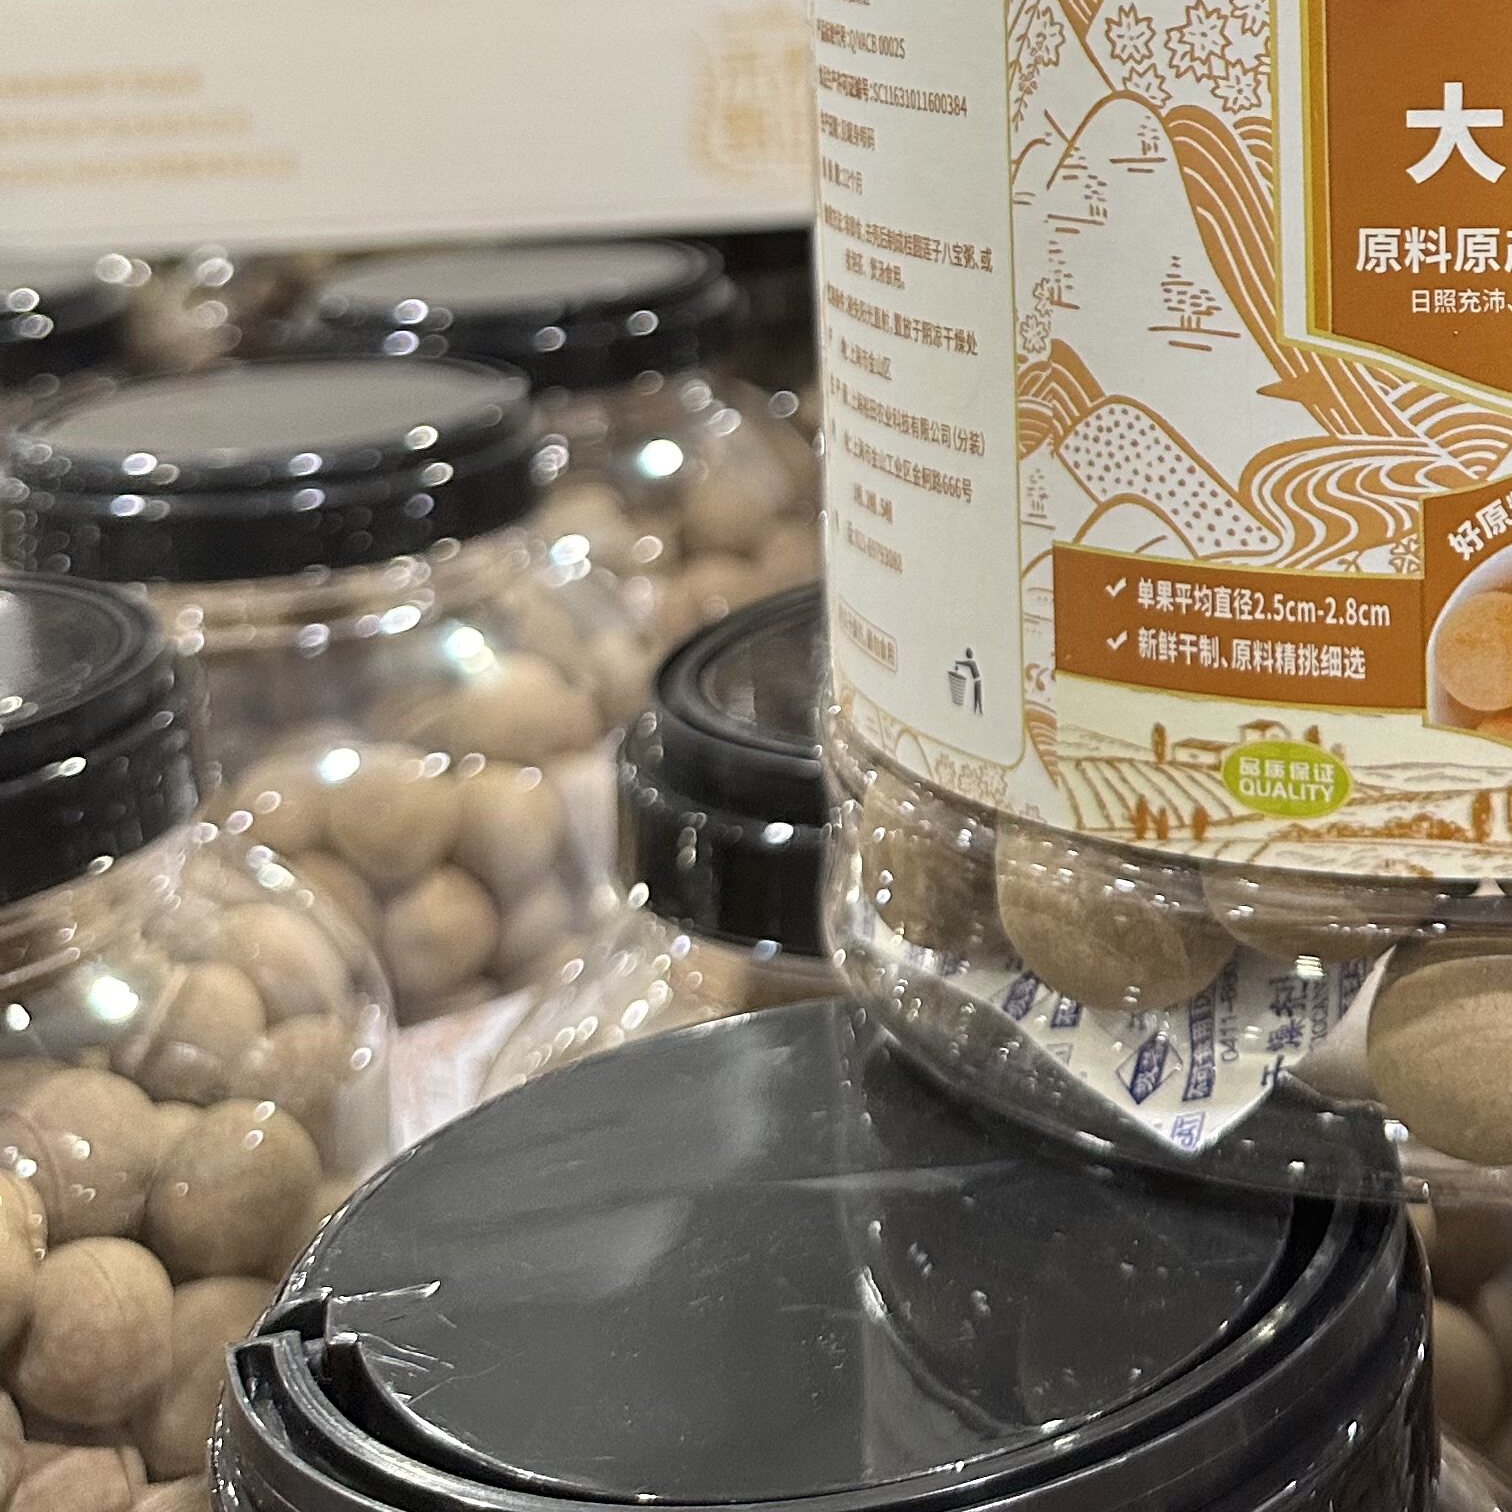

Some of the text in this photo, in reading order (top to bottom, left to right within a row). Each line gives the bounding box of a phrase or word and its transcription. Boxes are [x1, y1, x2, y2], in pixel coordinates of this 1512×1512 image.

[1138, 578, 1391, 627] 单果平均直径2.5cm-2.8cm
[1138, 627, 1367, 680] 新鲜干制、原料精挑细选
[1239, 756, 1335, 782] 品质保证
[1238, 777, 1335, 804] QUALITY
